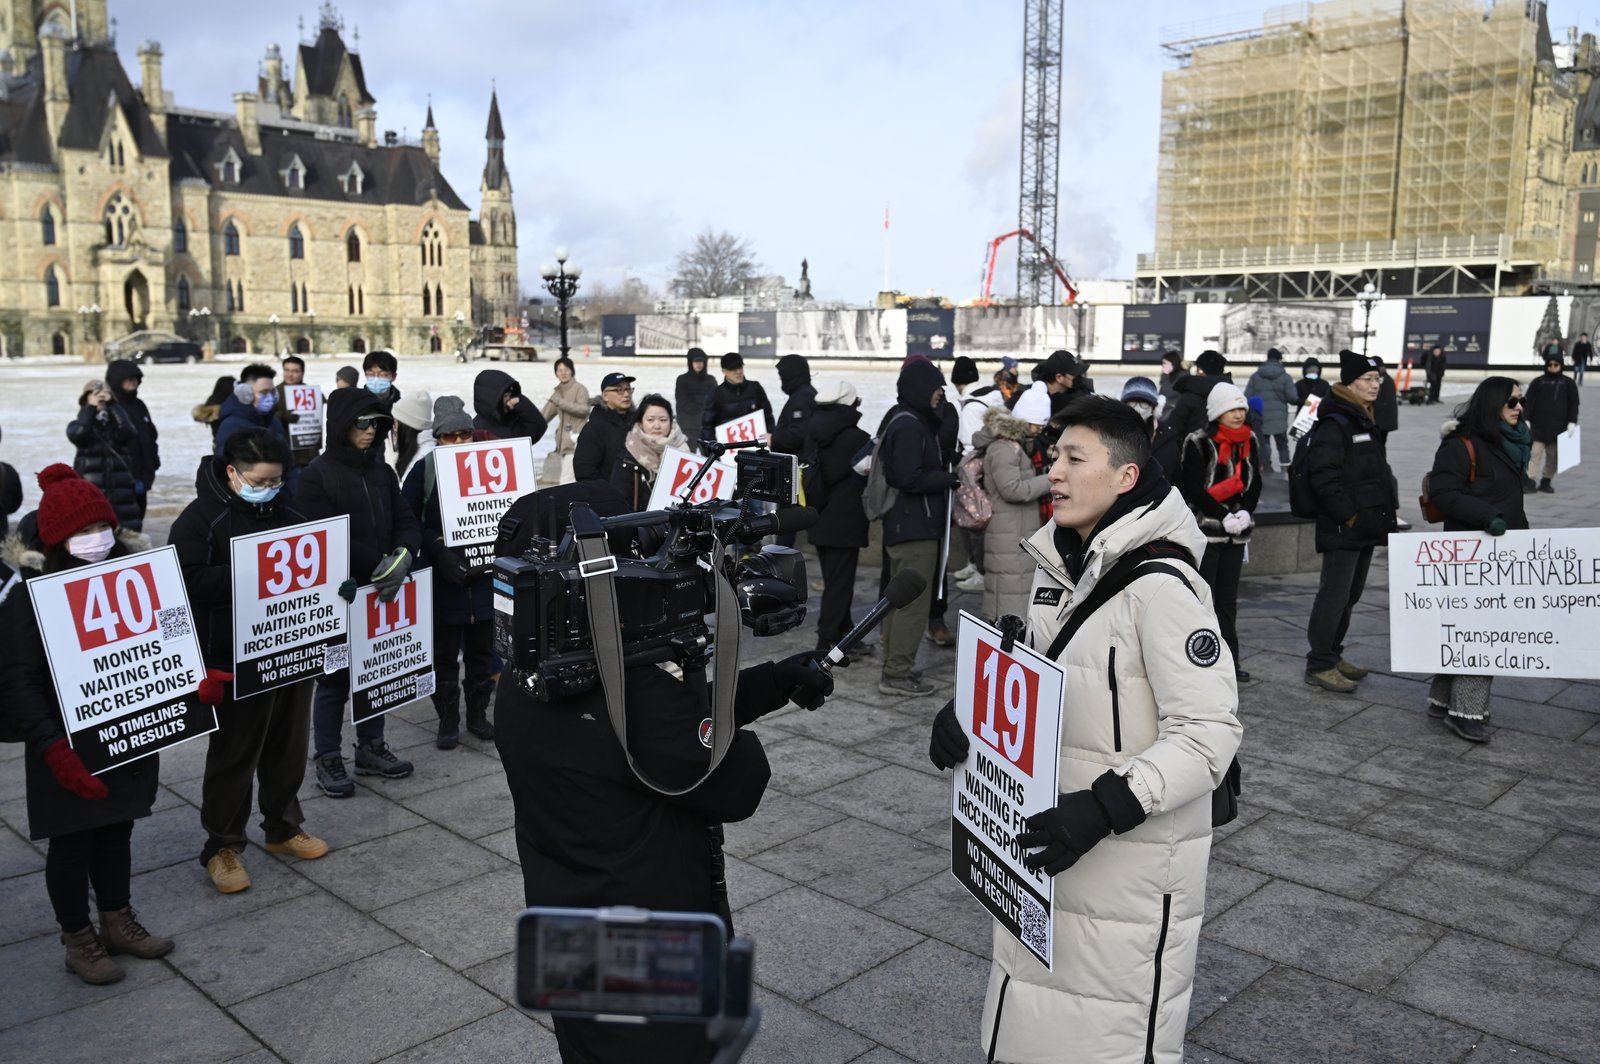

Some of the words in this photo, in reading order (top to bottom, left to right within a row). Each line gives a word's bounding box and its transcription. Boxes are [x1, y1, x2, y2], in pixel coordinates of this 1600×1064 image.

[295, 389, 315, 410] 25
[729, 421, 754, 448] 33
[464, 449, 508, 496] 19
[675, 461, 718, 505] 28
[457, 512, 502, 528] WAITING
[467, 497, 513, 513] MONTHS
[452, 530, 476, 542] IRCC
[1414, 539, 1483, 564] ASSEZ
[1488, 538, 1518, 562] des
[1526, 537, 1577, 561] délais
[265, 534, 320, 595] 39
[464, 547, 478, 558] NO
[470, 558, 483, 568] NO
[676, 580, 697, 589] SONY
[83, 568, 153, 642] 40
[266, 593, 320, 618] MONTHS
[374, 584, 410, 636] 11
[1404, 592, 1432, 610] Nos
[1435, 594, 1468, 610] vies
[1473, 592, 1507, 610] sont
[1513, 596, 1536, 610] en
[252, 612, 306, 636] WAITING
[309, 604, 334, 622] FOR
[243, 639, 273, 655] IRCC
[275, 618, 341, 647] RESPONSE
[373, 631, 412, 654] MONTHS
[1441, 624, 1560, 648] Transparence.
[93, 640, 162, 673] MONTHS
[257, 659, 272, 672] NO
[274, 643, 328, 667] TIMELINES
[262, 671, 277, 684] NO
[279, 656, 324, 678] RESULTS
[357, 670, 382, 685] IRCC
[381, 652, 428, 678] RESPONSE
[363, 648, 403, 671] WAITING
[404, 641, 422, 657] FOR
[1441, 644, 1490, 669] Délais
[1495, 648, 1550, 670] clairs.
[80, 663, 149, 698] WAITING
[152, 654, 184, 675] FOR
[75, 698, 113, 722] IRCC
[115, 669, 197, 709] RESPONSE
[367, 689, 379, 700] NO
[371, 698, 383, 710] NO
[384, 685, 416, 705] RESULTS
[980, 649, 1027, 763] 19
[98, 725, 119, 743] NO
[119, 701, 188, 736] TIMELINES
[108, 740, 128, 757] NO
[131, 718, 186, 750] RESULTS
[976, 751, 1024, 806] MONTHS
[965, 769, 1010, 826] WAITING
[1013, 809, 1032, 836] FO
[958, 791, 981, 829] IRCC
[981, 813, 1044, 884] RESPON
[967, 838, 979, 863] NO
[980, 850, 1024, 902] TIMELINE
[970, 864, 983, 888] NO
[984, 877, 1024, 929] RESULTS
